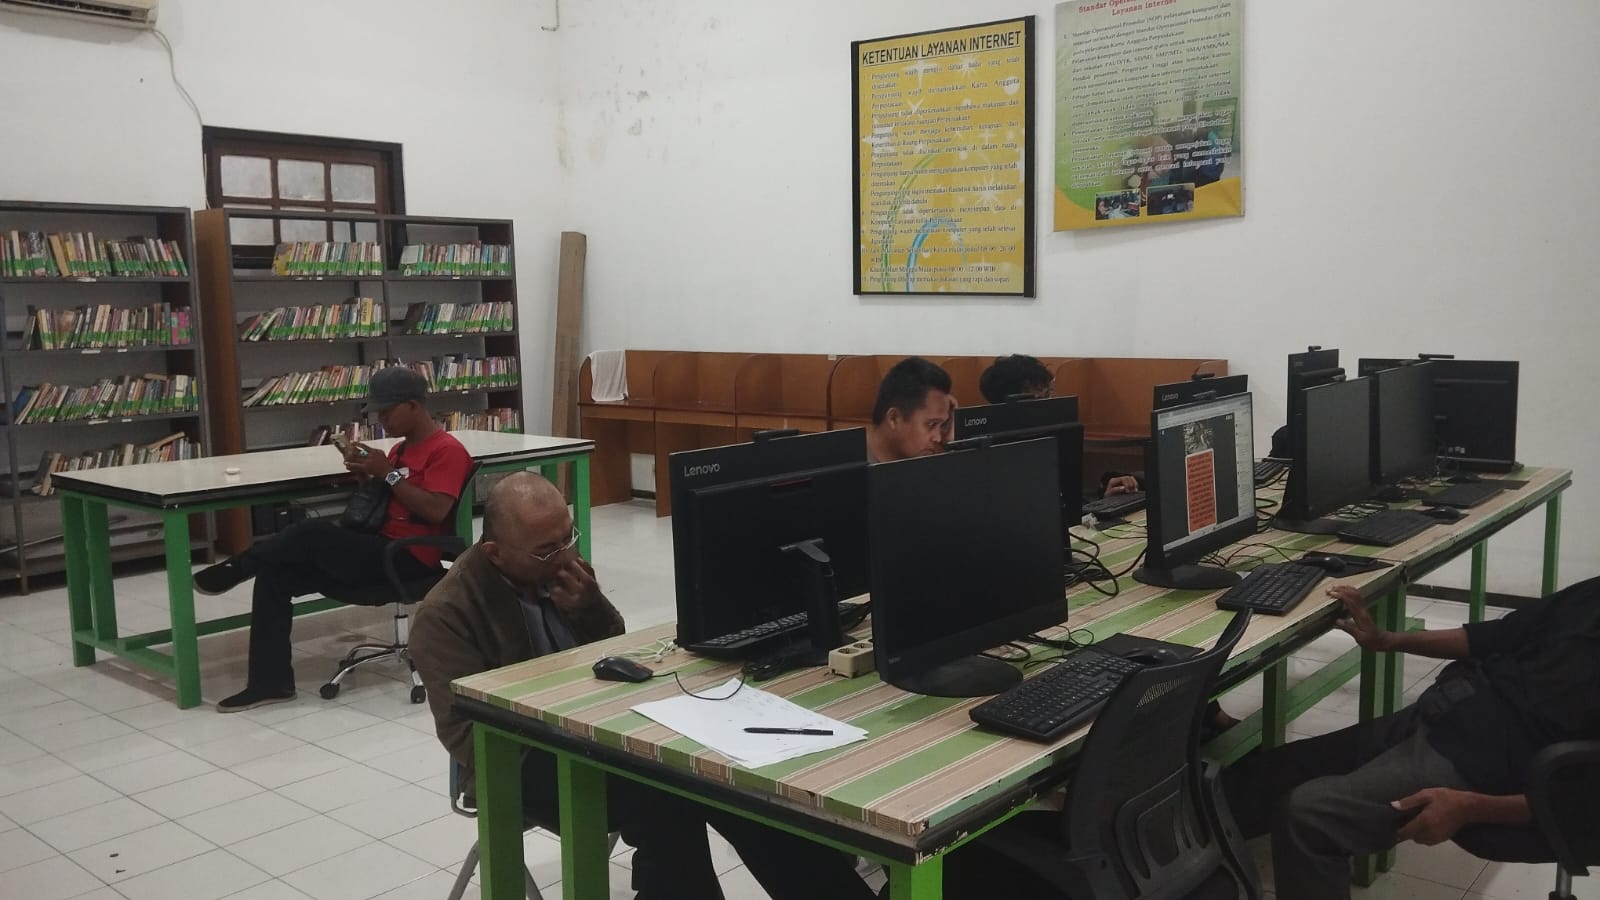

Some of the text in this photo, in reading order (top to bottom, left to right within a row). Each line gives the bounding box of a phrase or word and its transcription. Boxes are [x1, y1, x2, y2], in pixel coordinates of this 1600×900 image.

[1078, 2, 1107, 13] Standar
[1112, 4, 1143, 16] Layanan
[863, 31, 1021, 65] KETENTUAN LAYANAN INTERNET
[964, 415, 987, 427] Lenovo
[683, 463, 721, 478] Lenovo
